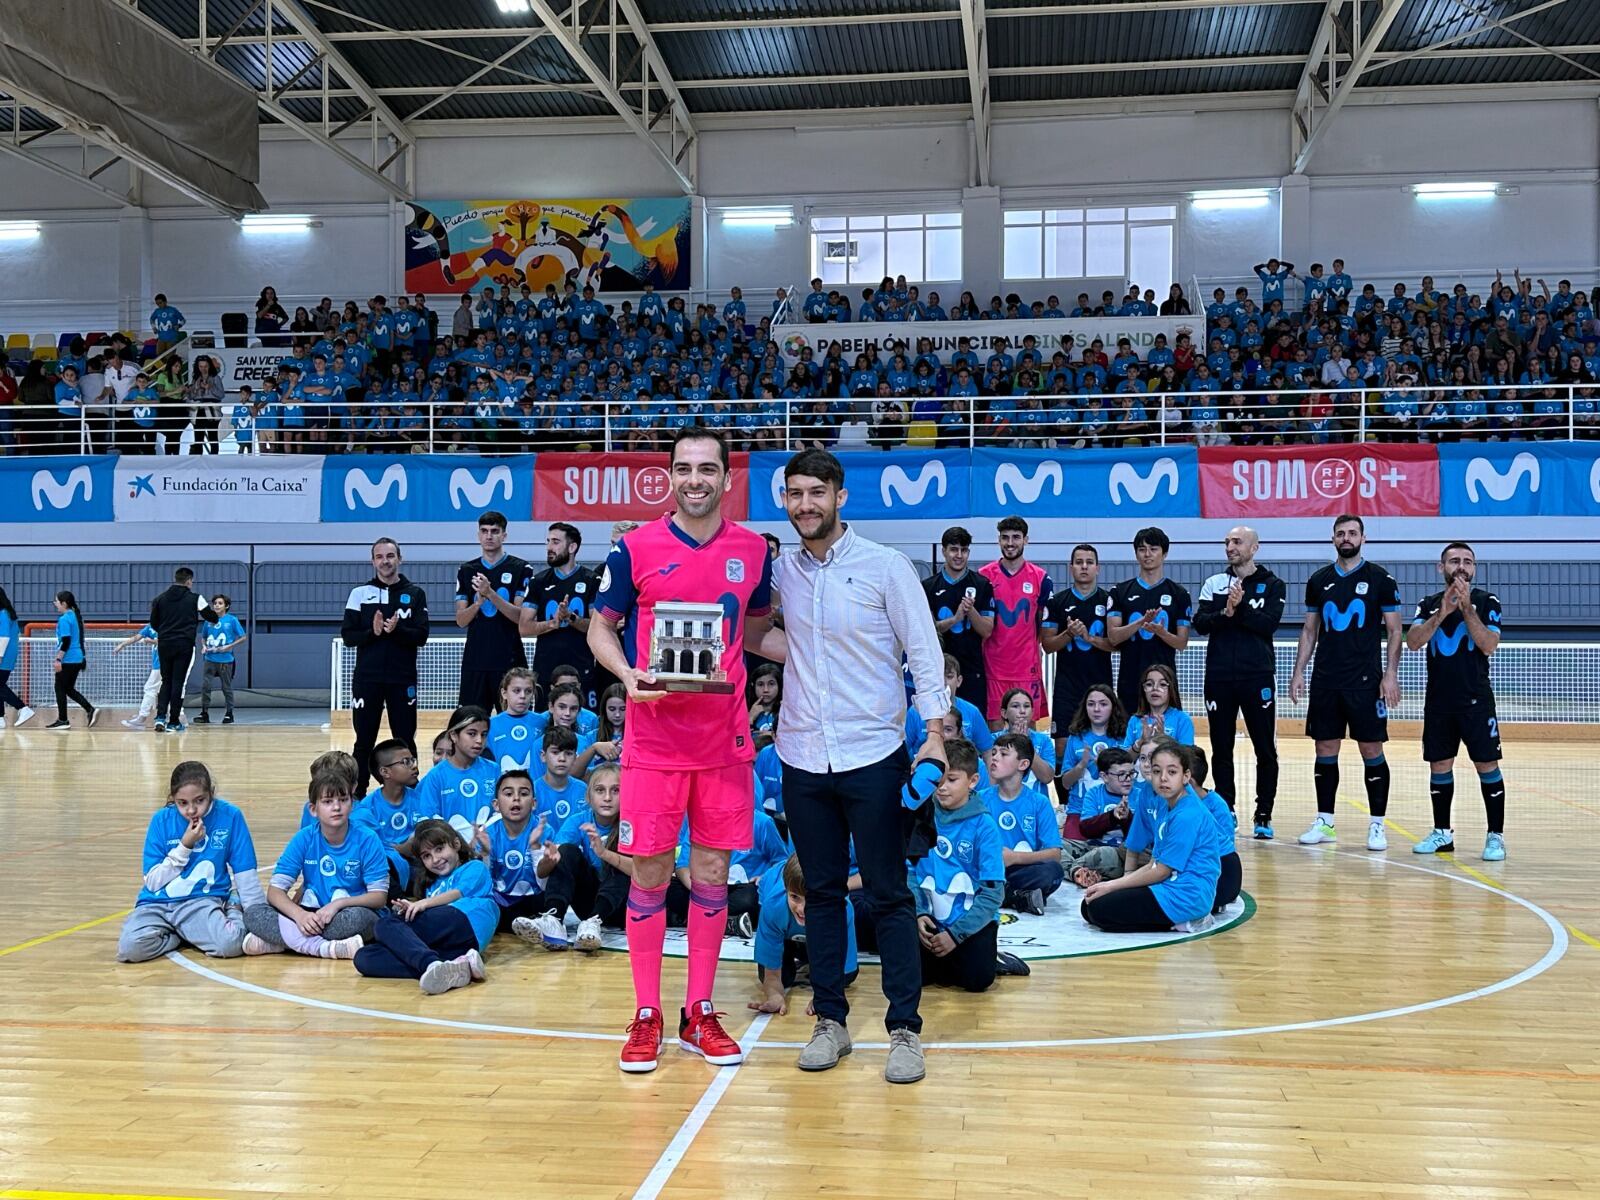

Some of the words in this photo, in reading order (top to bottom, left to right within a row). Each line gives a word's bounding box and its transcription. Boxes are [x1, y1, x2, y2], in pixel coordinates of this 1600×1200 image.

[443, 210, 477, 228] Puedo
[481, 208, 504, 220] porque
[542, 206, 555, 214] que
[561, 207, 591, 222] puedo
[236, 356, 257, 365] SAN
[234, 367, 271, 380] CREE
[162, 476, 238, 492] Fundación
